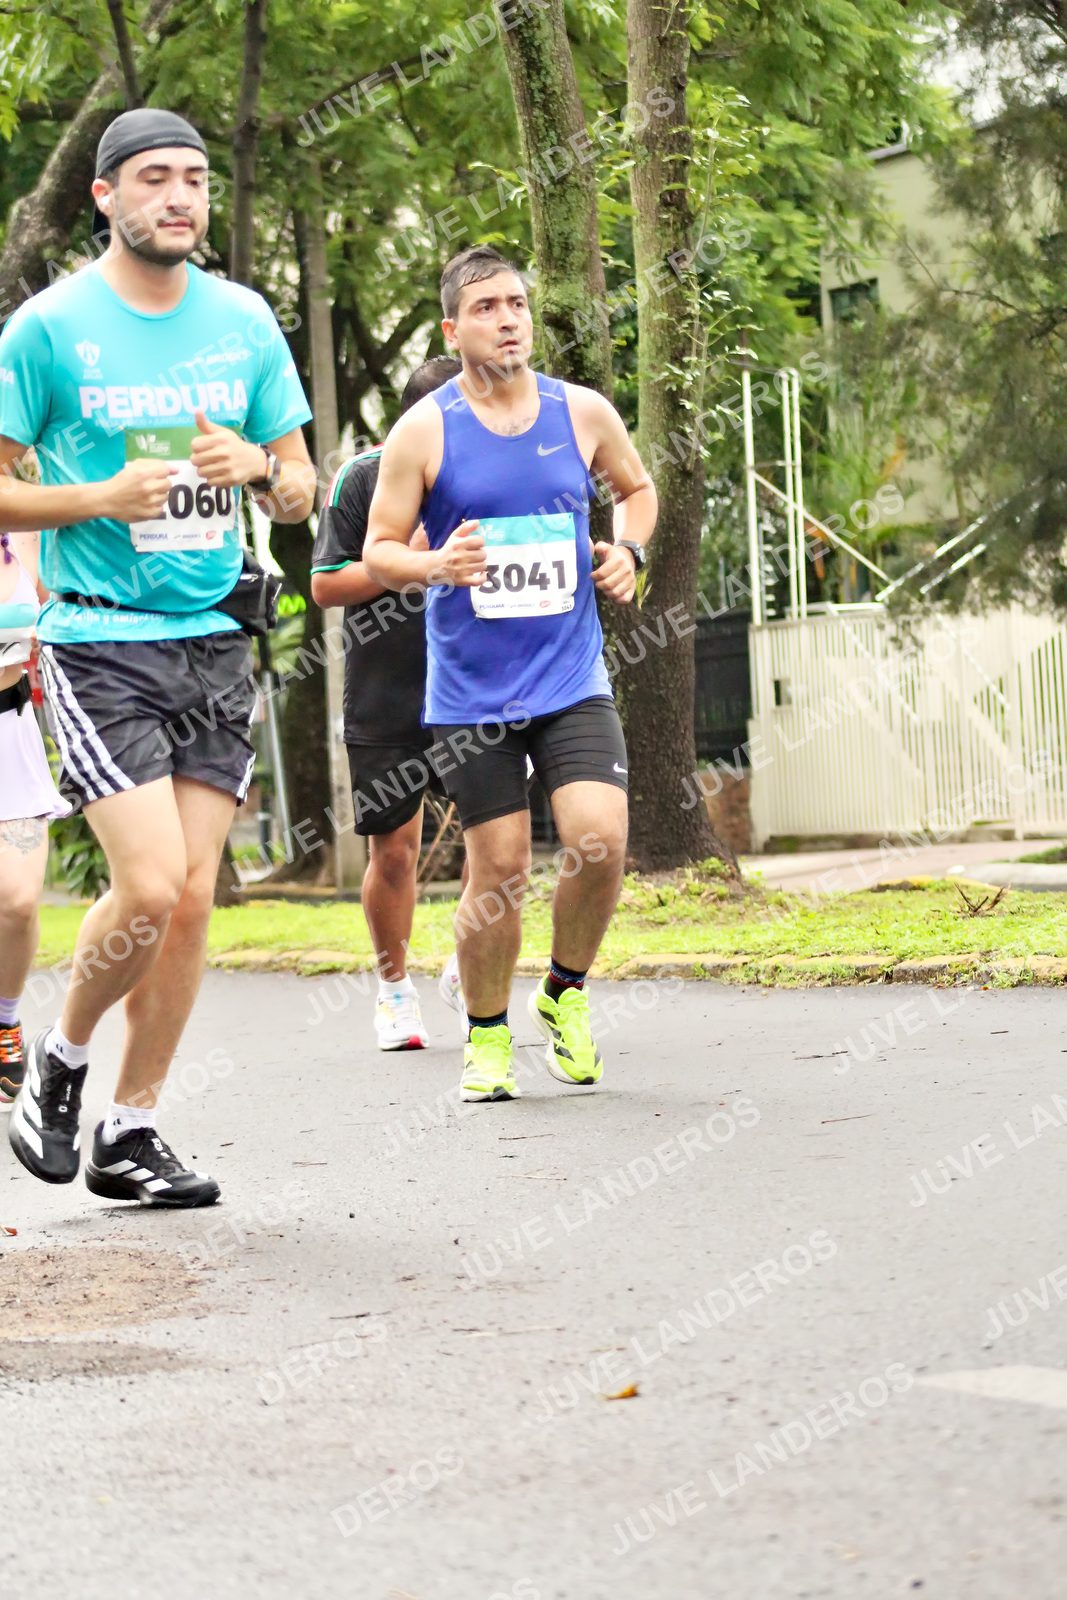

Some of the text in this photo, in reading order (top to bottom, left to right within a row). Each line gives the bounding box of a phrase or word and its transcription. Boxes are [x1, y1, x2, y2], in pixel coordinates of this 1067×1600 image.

[79, 378, 248, 418] PERDURA
[157, 483, 232, 520] 060
[478, 560, 566, 594] 3041
